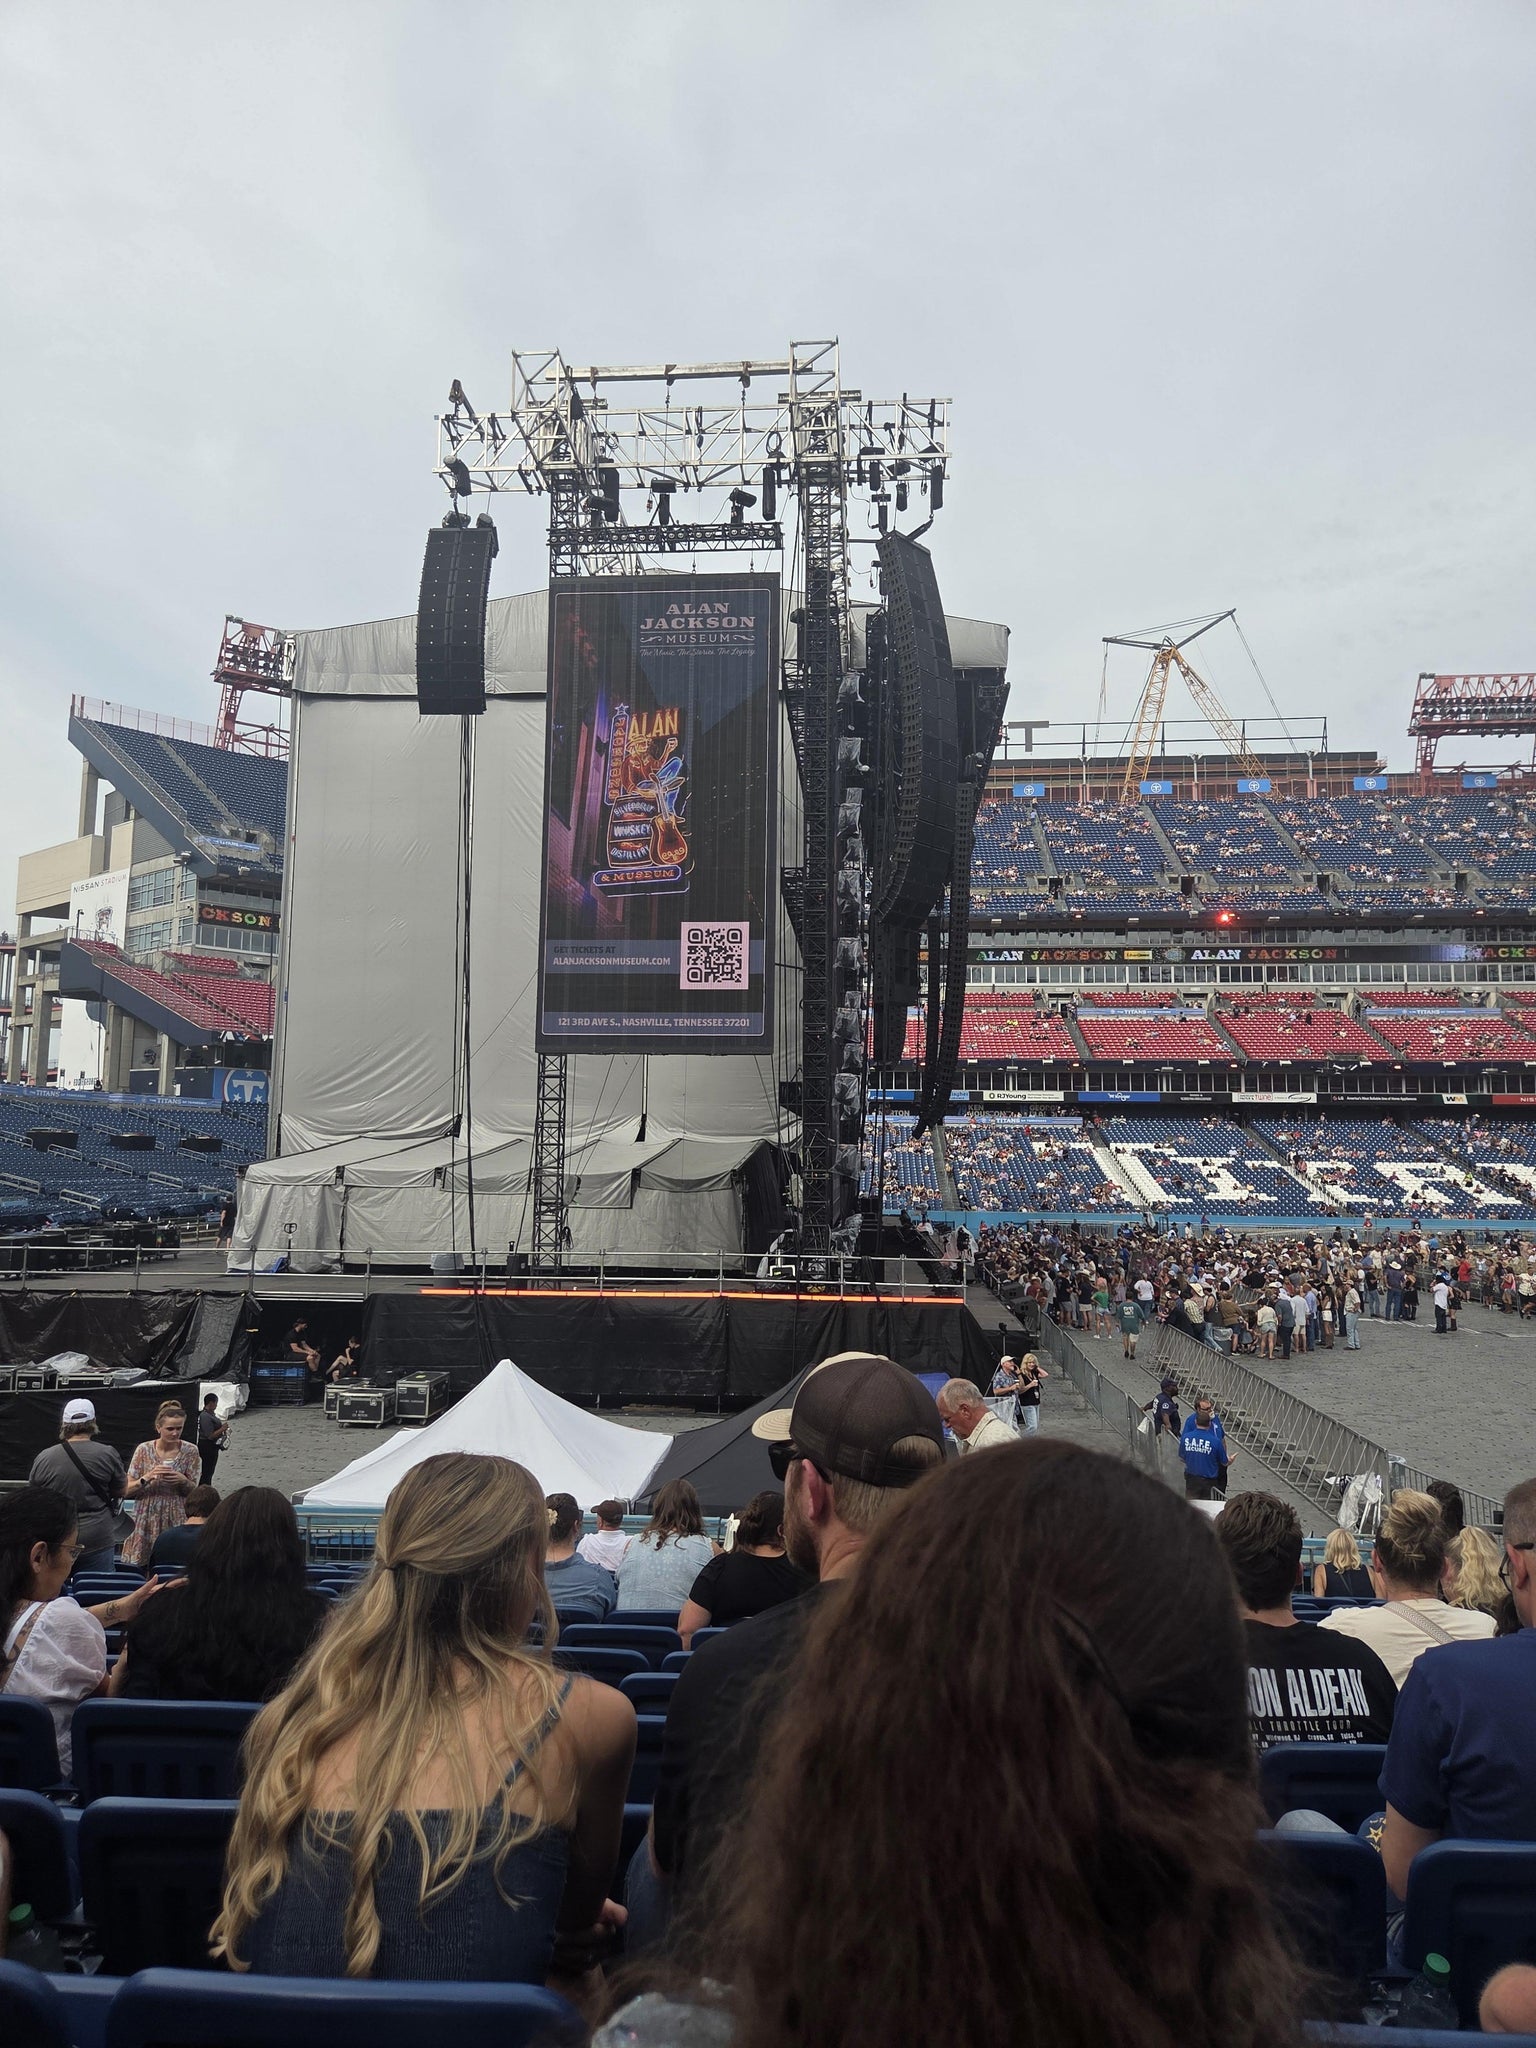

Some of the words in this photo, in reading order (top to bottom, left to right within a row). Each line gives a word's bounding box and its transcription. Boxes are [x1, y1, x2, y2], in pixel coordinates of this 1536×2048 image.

[666, 603, 730, 615] ALAN
[640, 616, 756, 630] JACKSON
[666, 634, 730, 643] MUSEUM
[628, 708, 679, 741] ALAN
[613, 824, 651, 837] WHISKEY
[613, 870, 675, 880] MUSEUM
[73, 882, 99, 894] NISSAN
[101, 874, 127, 887] STADIUM
[554, 946, 569, 954] GET
[570, 946, 604, 954] TICKETS
[605, 946, 616, 954] AT
[976, 951, 1025, 961] ALAN
[1031, 950, 1118, 961] JACKSON
[1191, 949, 1242, 960] ALAN
[1247, 949, 1338, 959] JACKSON
[553, 957, 671, 965] ALANJACKSONMUSEUM.COM
[558, 1018, 570, 1026] 121
[572, 1018, 590, 1026] 3RD
[591, 1018, 608, 1026] AVE
[622, 1018, 672, 1027] NASHVILLE,
[674, 1018, 724, 1027] TENNESSEE
[724, 1018, 750, 1027] 37201
[36, 1089, 60, 1097] TITANS
[157, 1097, 181, 1105] TITANS
[1185, 1446, 1212, 1454] SECURITY
[1247, 1667, 1284, 1717] ON
[1285, 1668, 1370, 1717] ALDEAN
[1270, 1720, 1320, 1731] THROTTLE
[1326, 1720, 1351, 1731] TOUR
